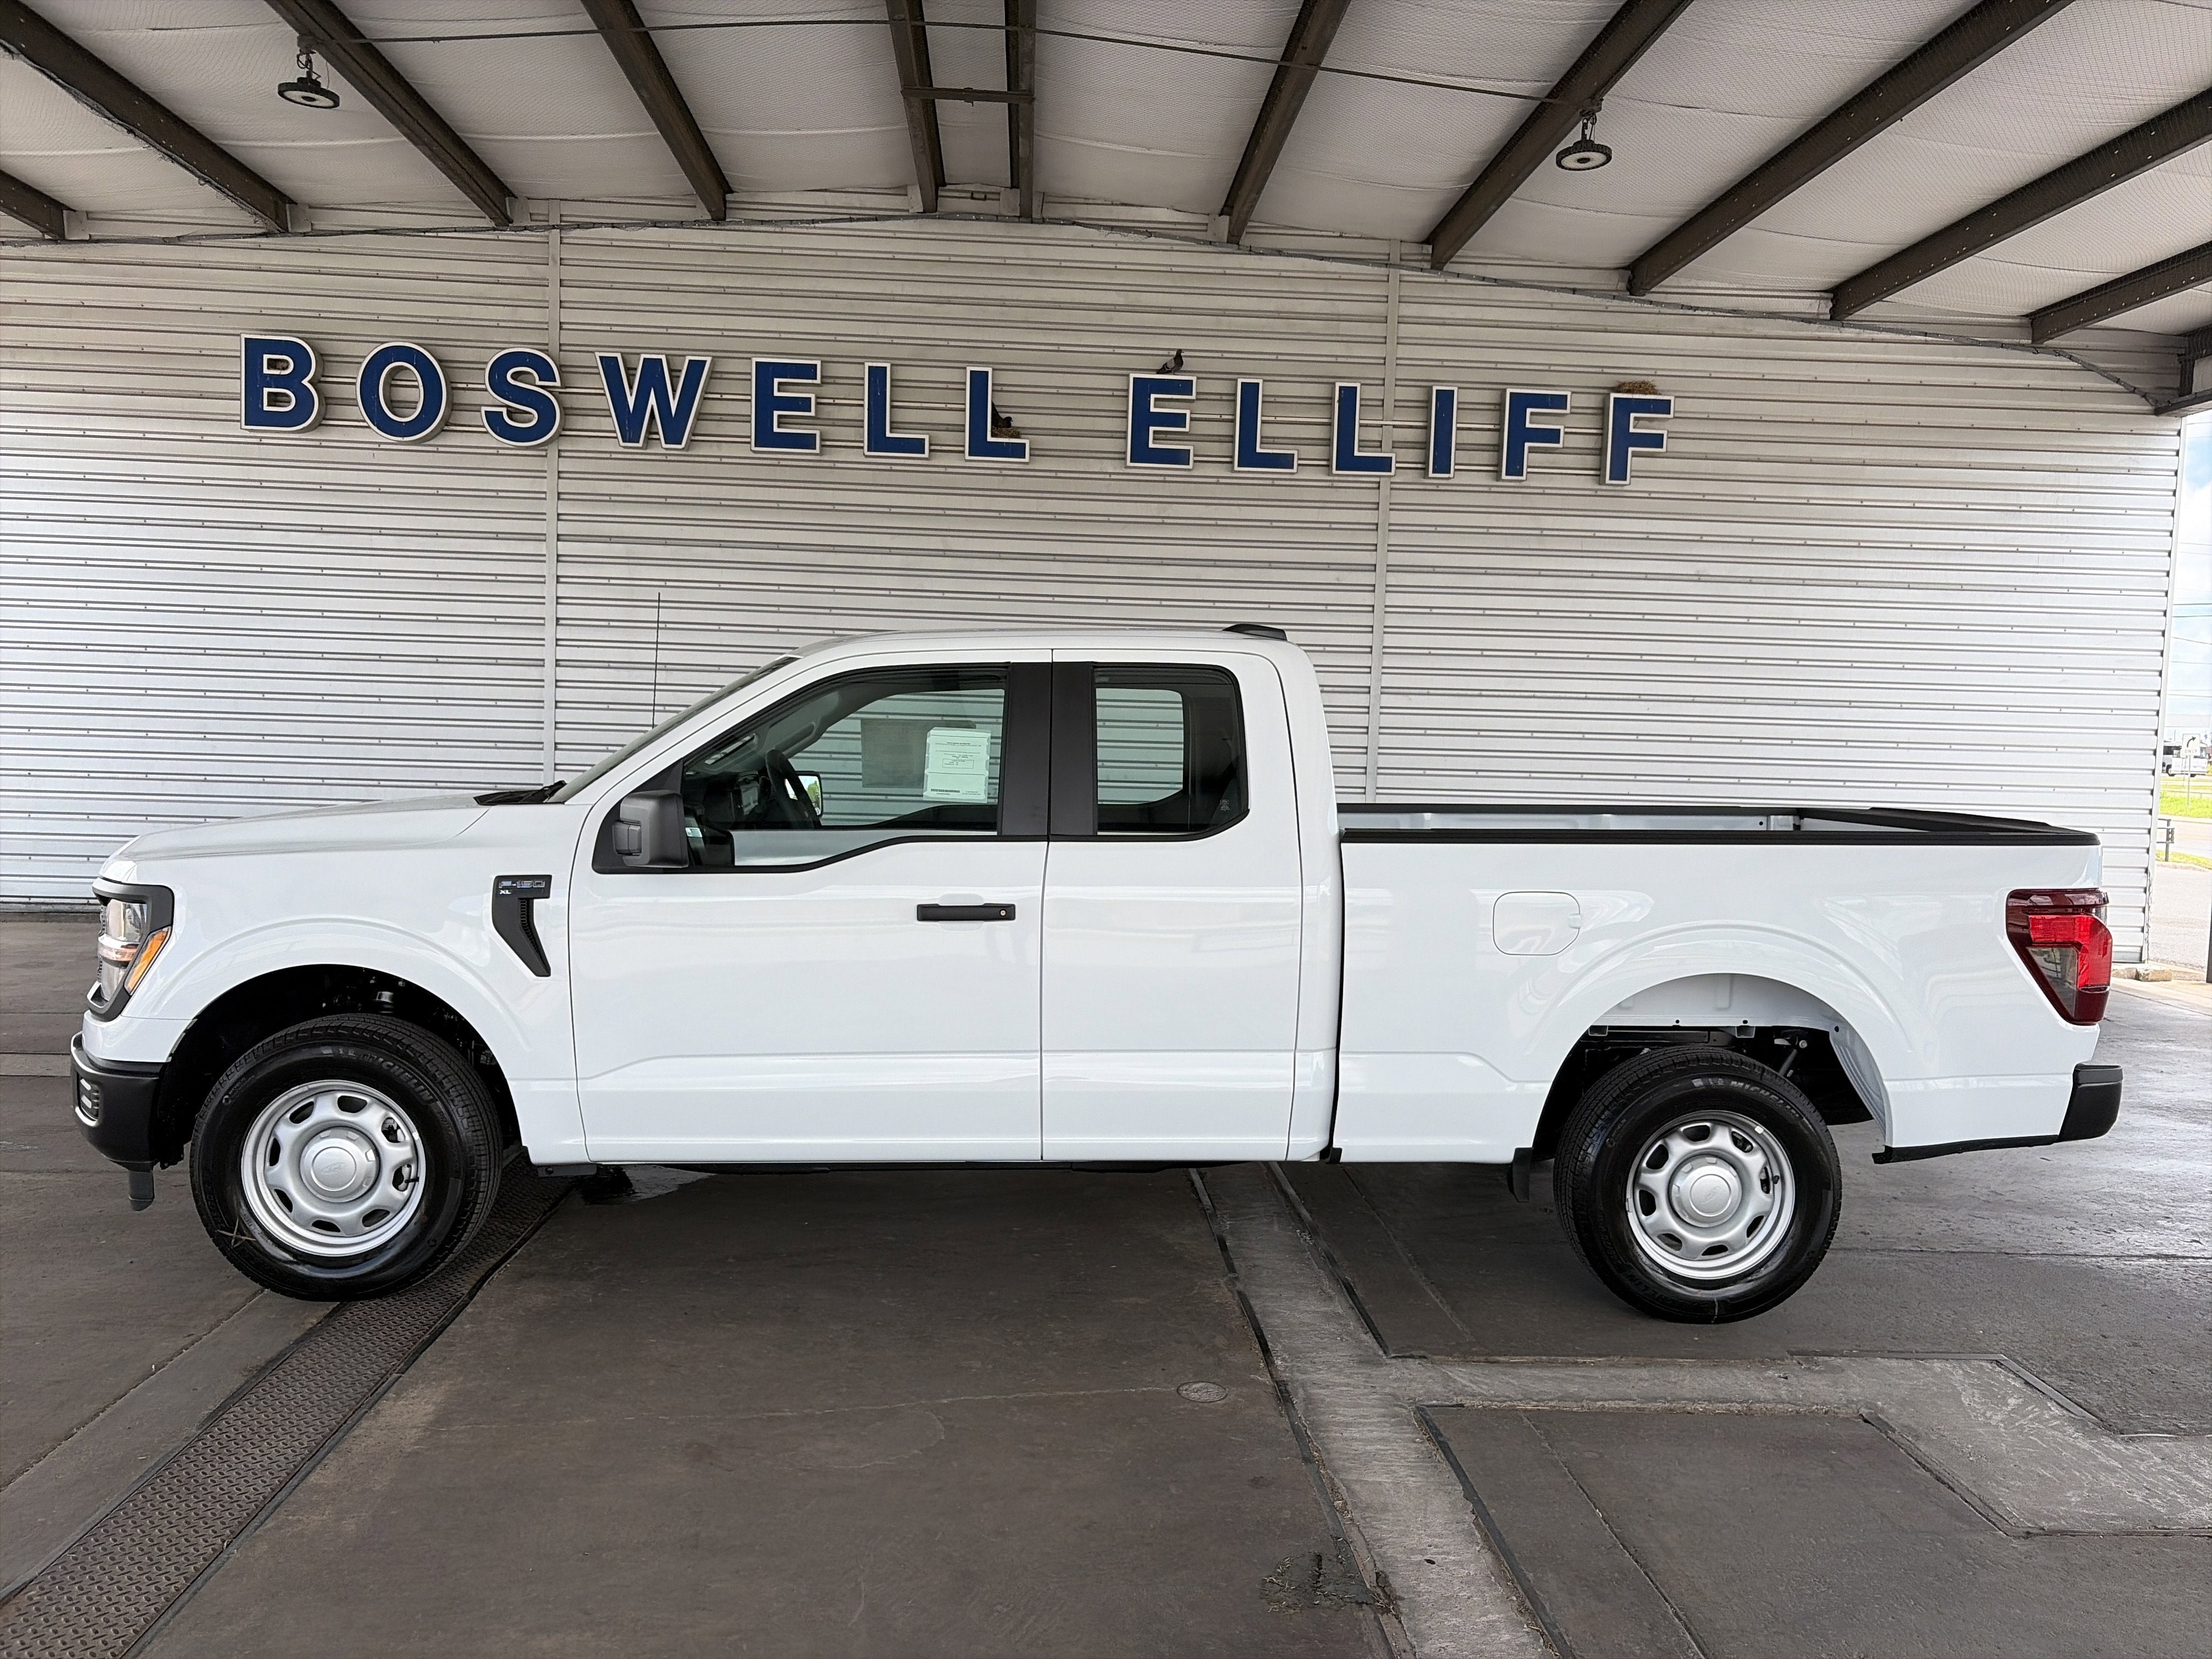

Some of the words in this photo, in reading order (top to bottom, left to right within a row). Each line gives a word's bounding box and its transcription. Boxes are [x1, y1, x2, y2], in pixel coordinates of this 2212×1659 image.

[240, 334, 1030, 462] BOSWELL
[1126, 374, 1674, 484] ELLIFF
[499, 880, 545, 888] F-150
[360, 1053, 433, 1101] MICHELIN
